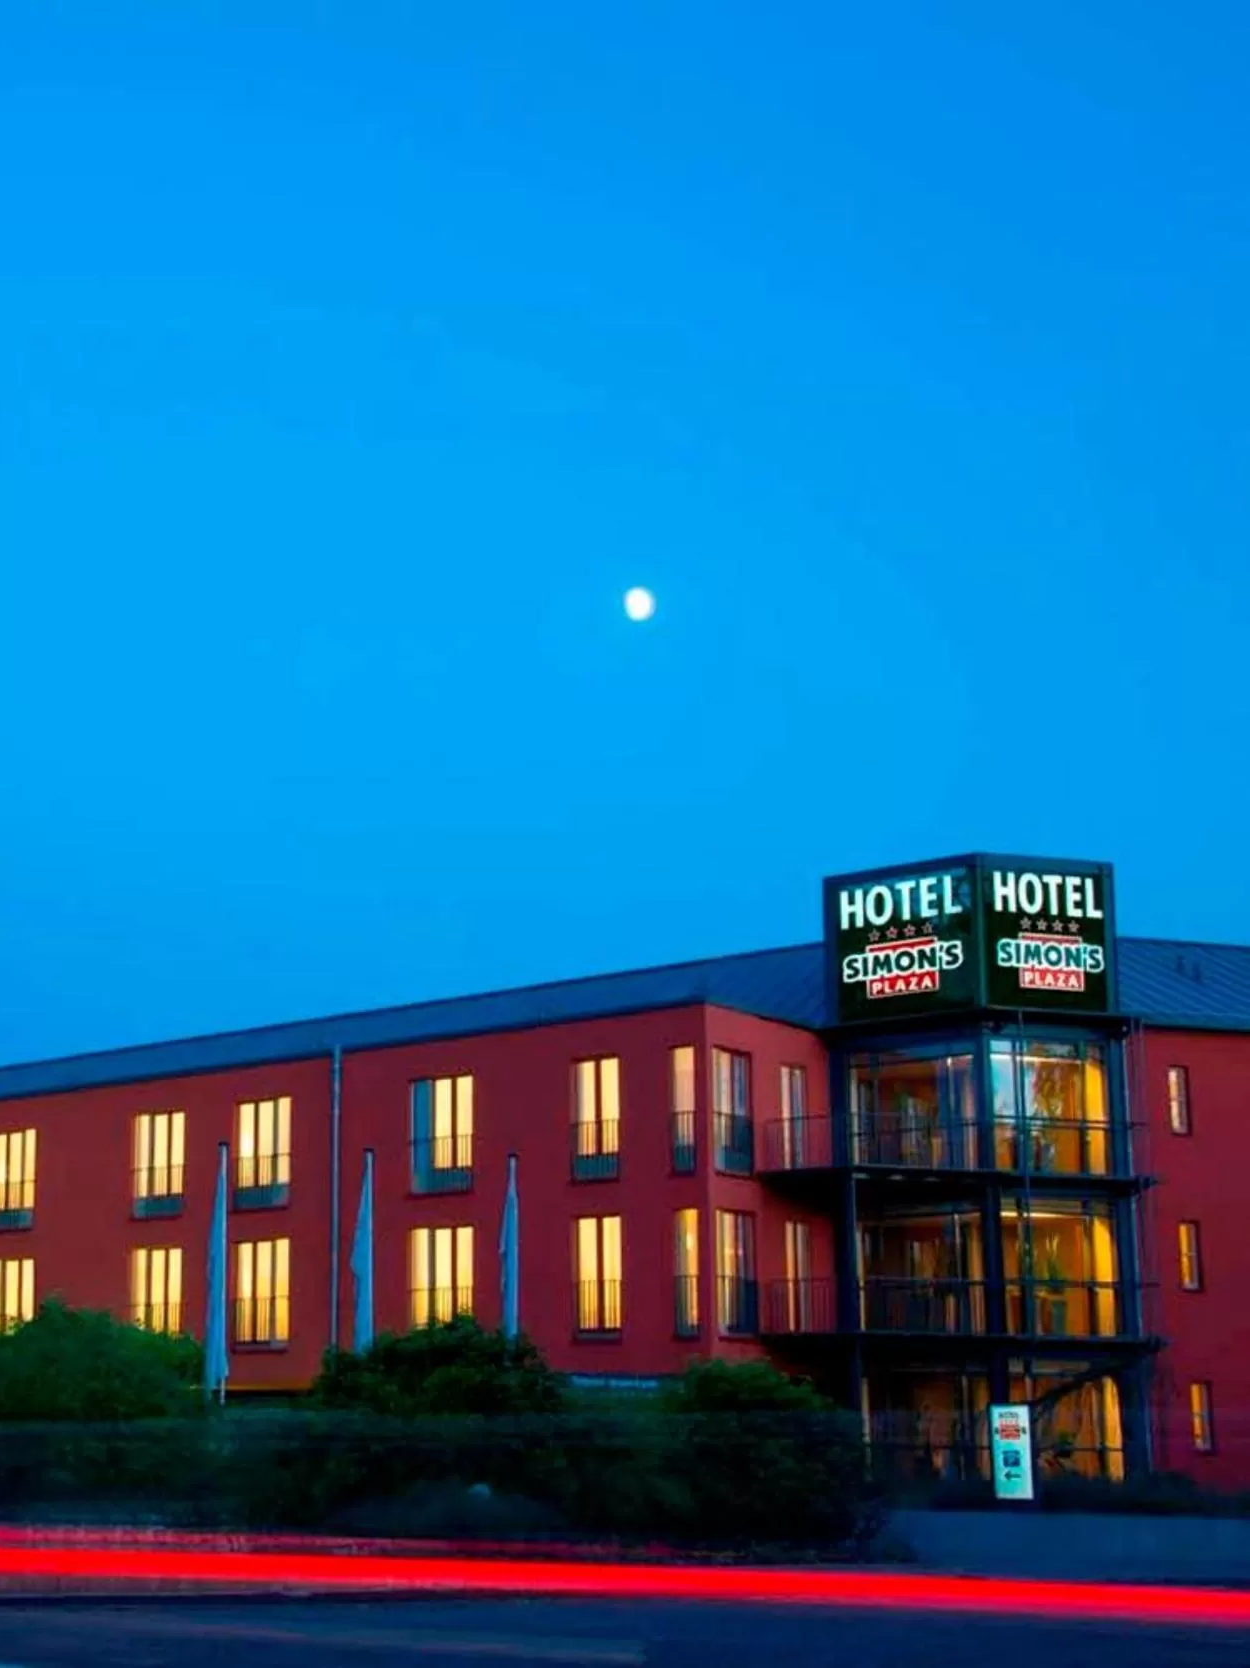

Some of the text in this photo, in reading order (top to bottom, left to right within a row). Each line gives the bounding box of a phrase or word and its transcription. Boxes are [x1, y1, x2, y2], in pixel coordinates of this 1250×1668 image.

[840, 875, 963, 930] HOTEL
[993, 871, 1103, 918] HOTEL
[844, 942, 962, 981] SIMON'S
[998, 940, 1103, 971] SIMON'S
[872, 975, 933, 995] PLAZA
[1024, 971, 1079, 988] PLAZA
